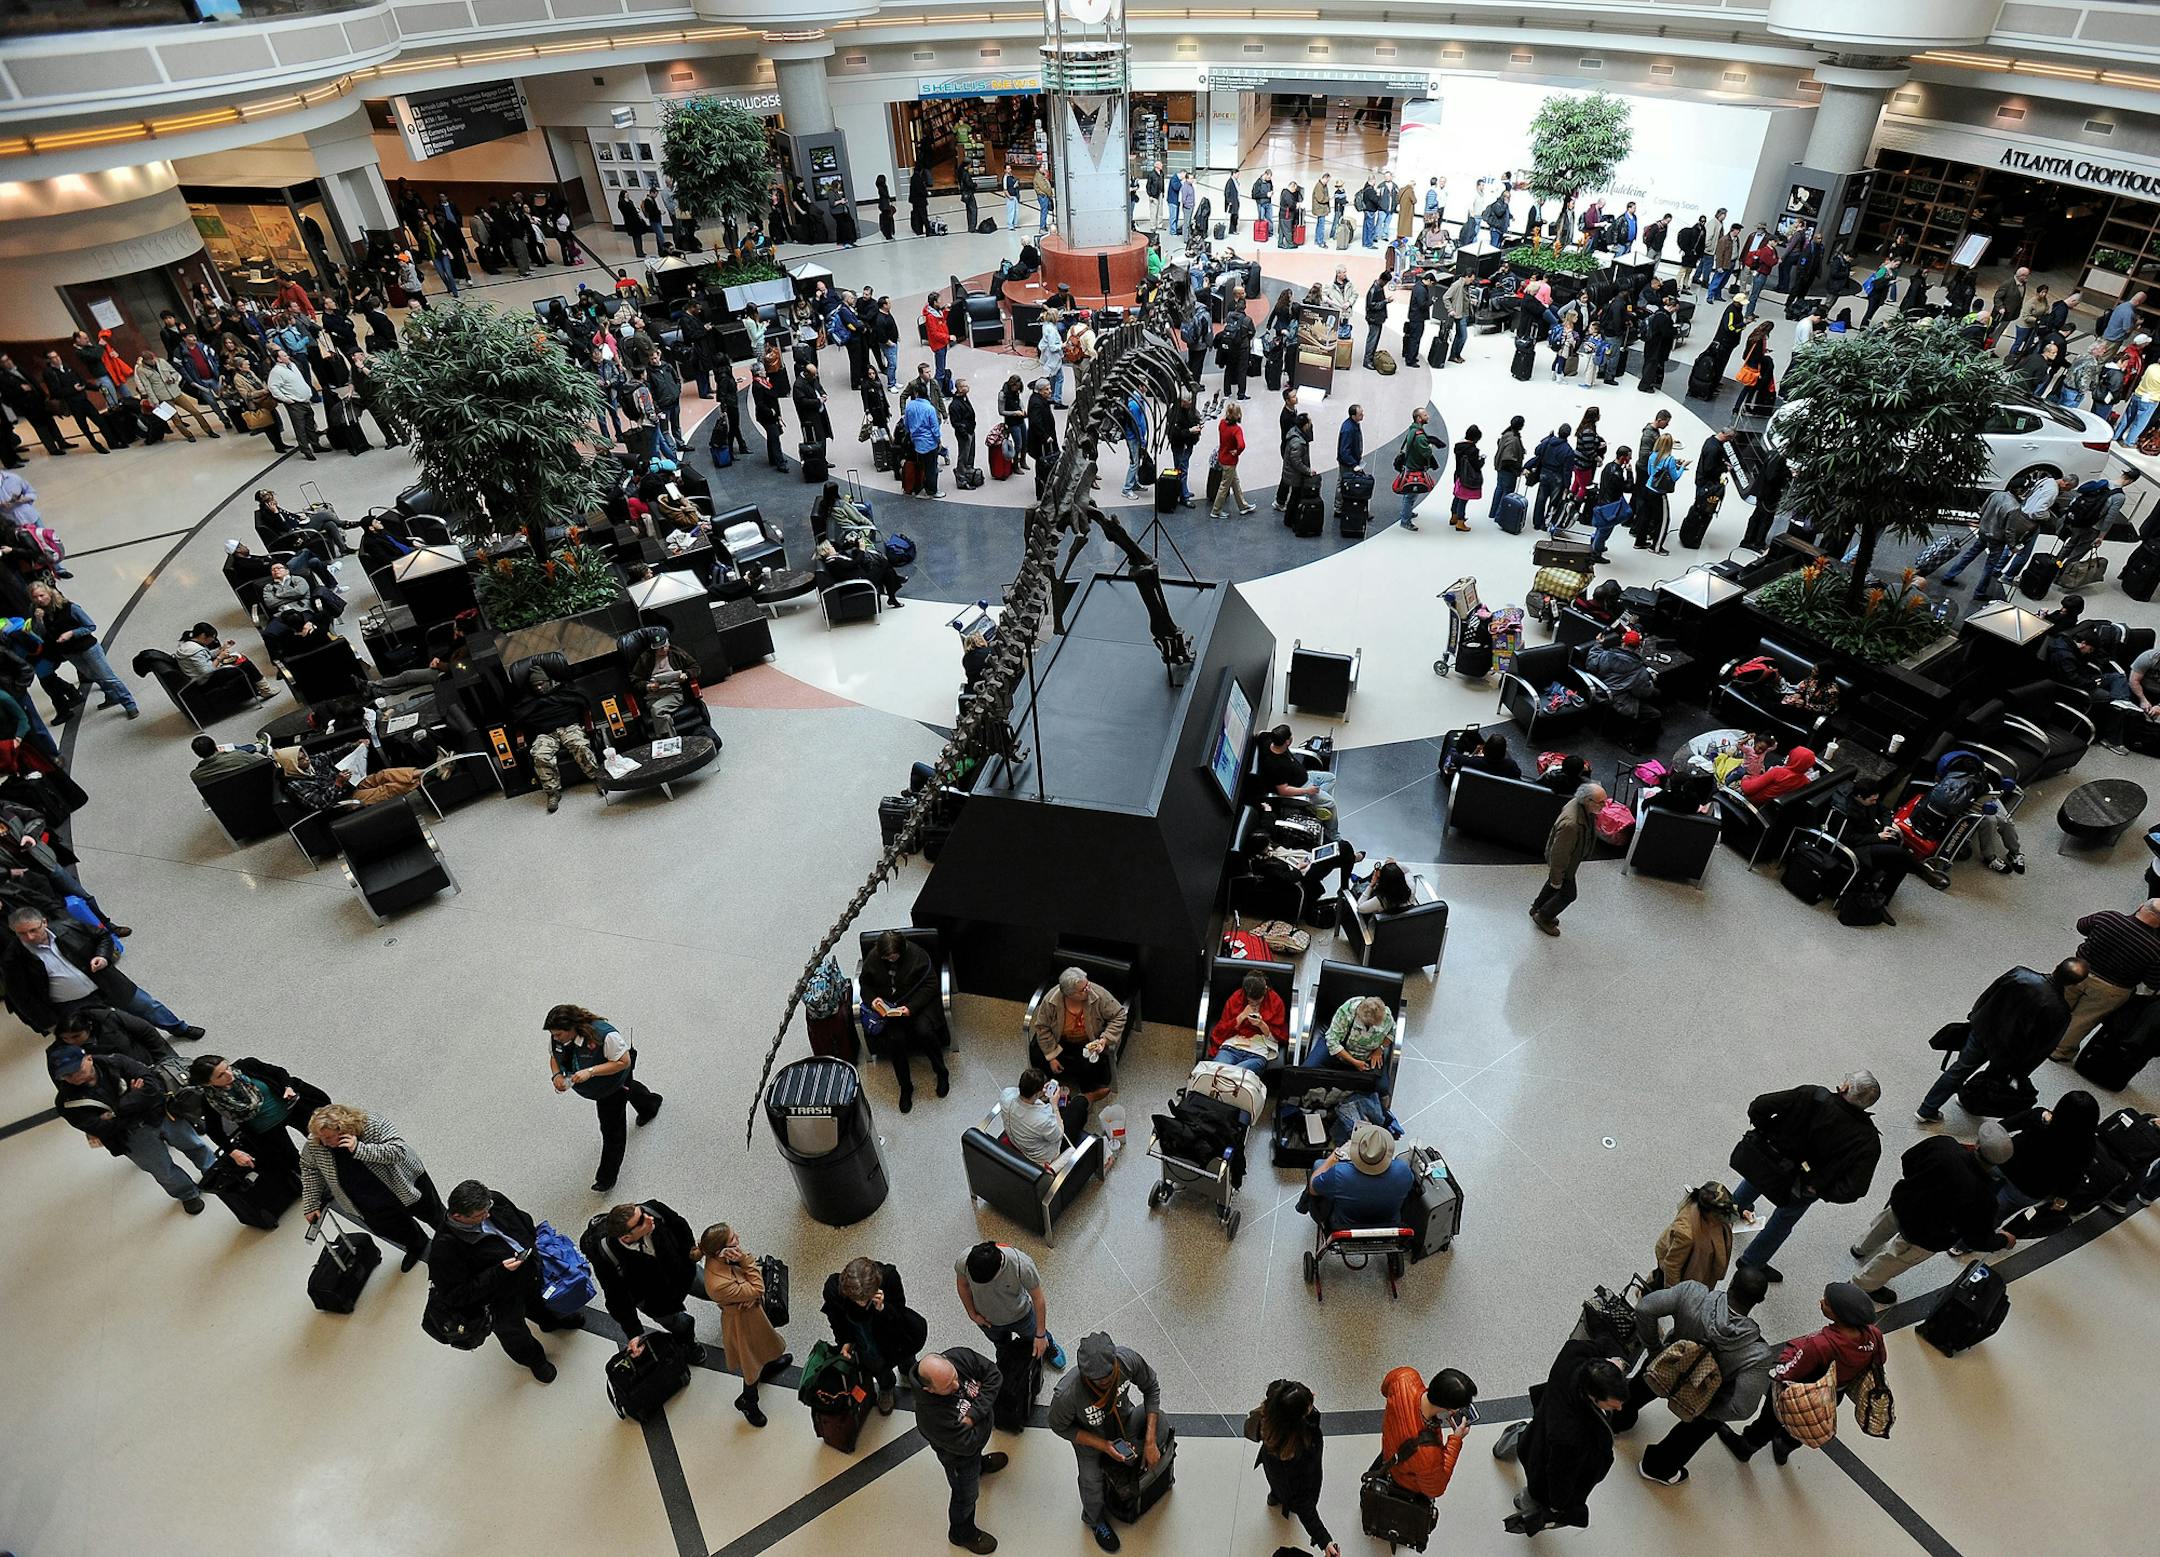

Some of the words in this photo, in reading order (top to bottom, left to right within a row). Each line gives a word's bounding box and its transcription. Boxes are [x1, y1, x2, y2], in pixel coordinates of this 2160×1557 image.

[1213, 68, 1284, 78] DOMESTIC
[1296, 70, 1367, 81] TERMINAL
[1379, 72, 1426, 82] NORTH
[991, 79, 1038, 89] NEWS
[2000, 148, 2074, 177] ATLANTA
[1654, 196, 1680, 209] Coming
[1681, 201, 1699, 211] Soon
[788, 1106, 832, 1115] TRASH
